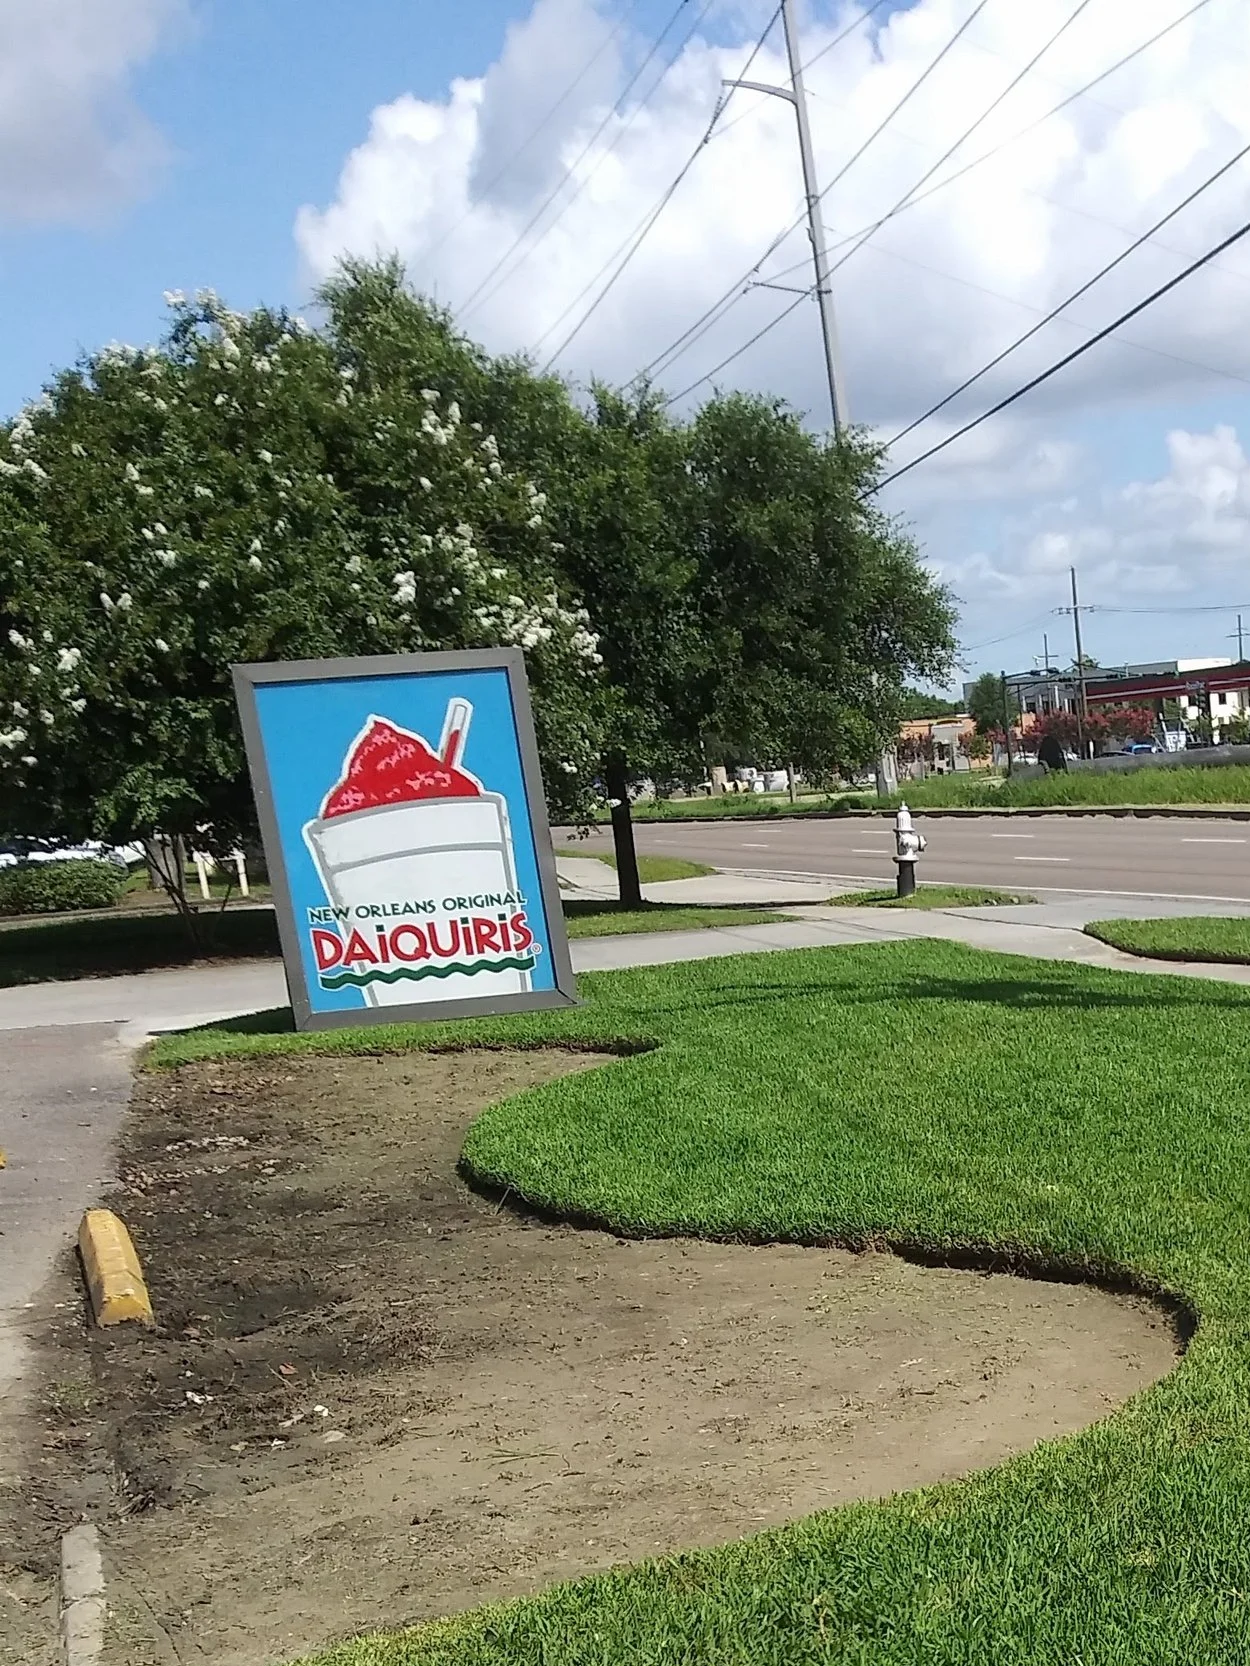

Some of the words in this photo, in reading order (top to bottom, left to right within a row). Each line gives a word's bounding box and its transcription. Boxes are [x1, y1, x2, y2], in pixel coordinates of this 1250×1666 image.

[310, 907, 349, 923] NEW
[355, 900, 436, 919] ORLEANS
[442, 891, 526, 911] ORIGINAL
